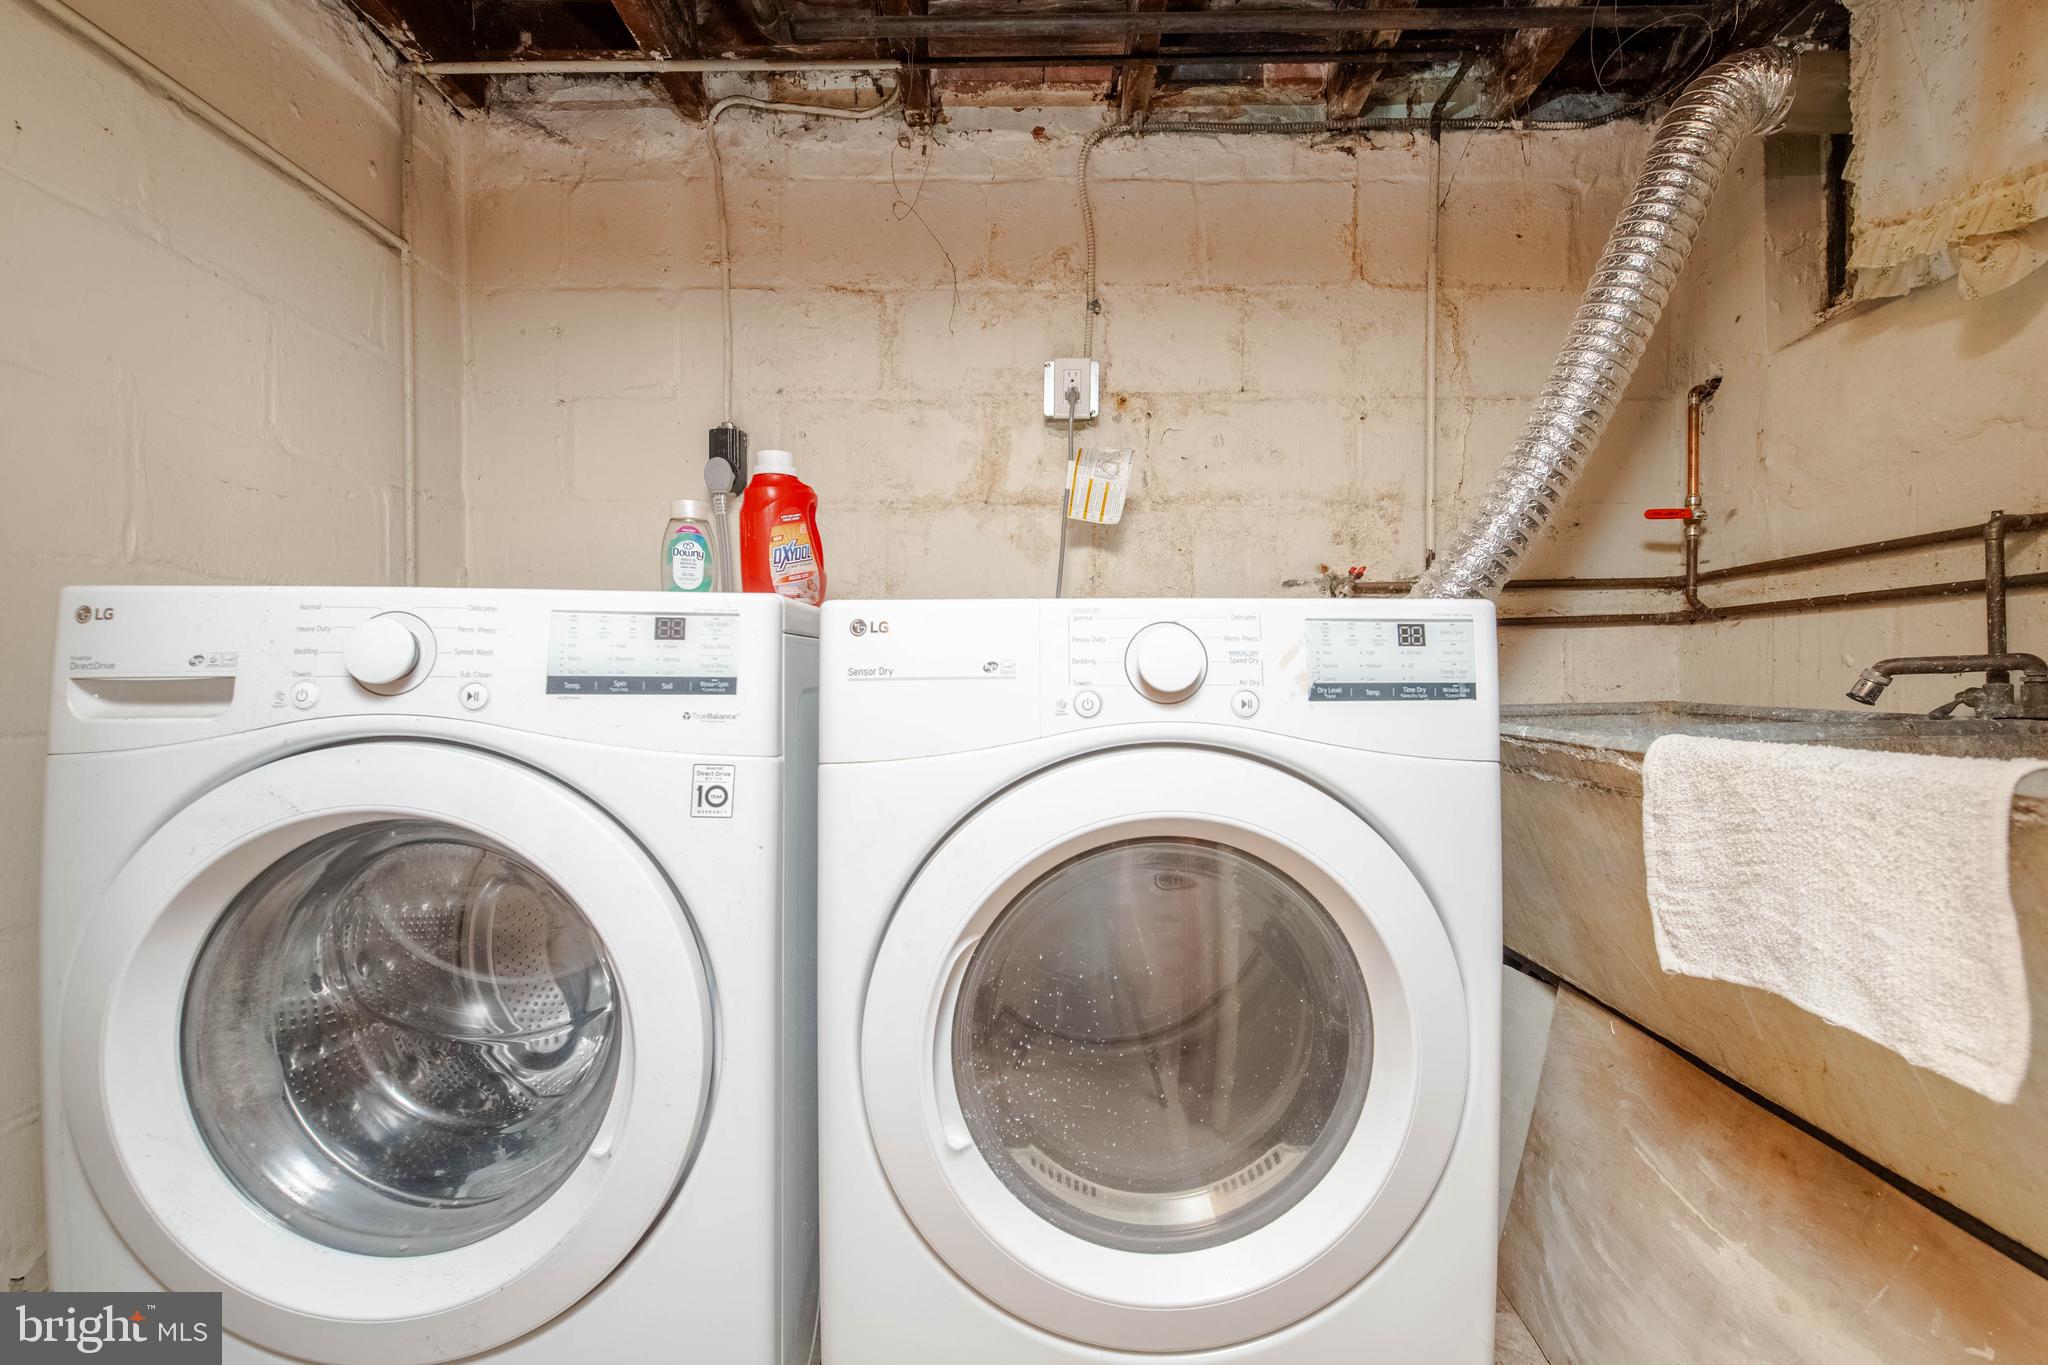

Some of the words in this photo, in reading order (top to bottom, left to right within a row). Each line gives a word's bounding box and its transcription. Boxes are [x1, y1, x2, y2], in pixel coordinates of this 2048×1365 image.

[672, 547, 704, 561] Downy
[773, 539, 812, 572] OXYDOL
[95, 607, 115, 621] LG
[870, 621, 889, 634] LG
[848, 667, 877, 678] Sensor
[878, 667, 894, 678] Dry
[661, 682, 674, 691] Soil
[1249, 679, 1261, 688] Dry
[1317, 686, 1327, 697] Dry
[1328, 686, 1343, 695] Level
[1402, 686, 1416, 694] Time
[1416, 686, 1428, 695] Dry
[692, 711, 736, 721] TrueBalance
[696, 784, 729, 808] 10
